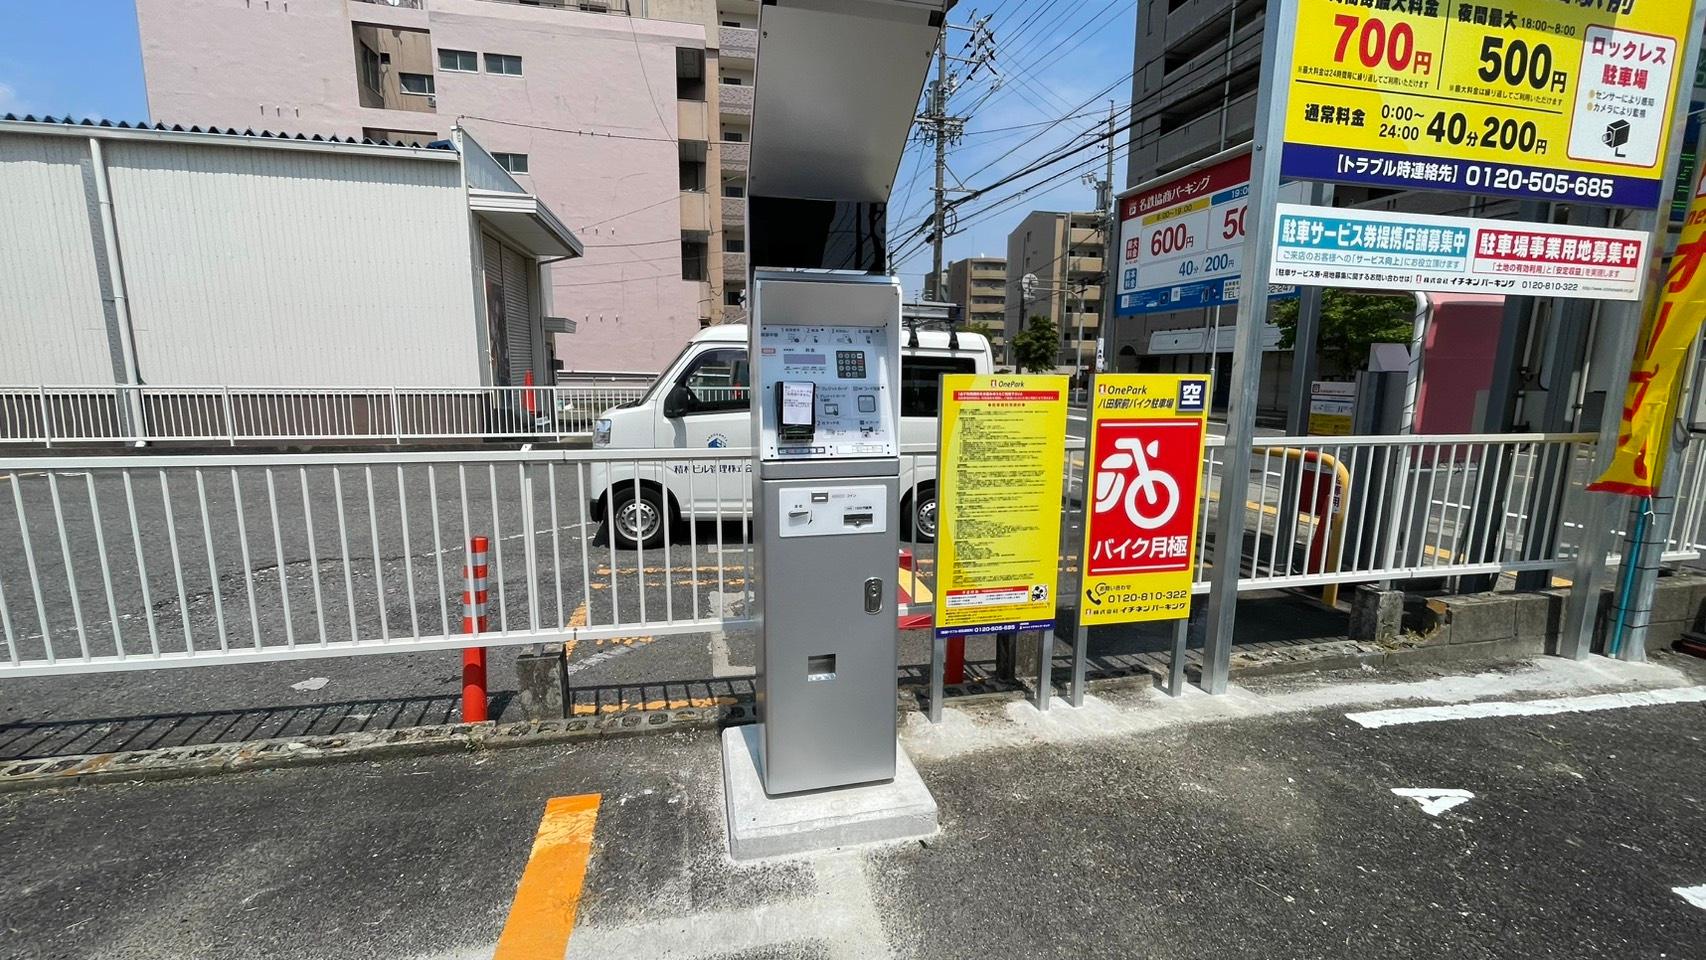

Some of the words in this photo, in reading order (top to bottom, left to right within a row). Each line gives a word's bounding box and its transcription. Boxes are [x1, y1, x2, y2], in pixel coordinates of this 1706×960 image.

[1458, 3, 1518, 30] 夜間最大
[1333, 14, 1432, 75] 700円
[1591, 36, 1667, 65] ロックレス
[1477, 35, 1567, 93] 500円
[1601, 64, 1649, 90] 駐車場
[1305, 103, 1366, 127] 通常料金
[1379, 123, 1419, 141] 24:00
[1465, 165, 1614, 199] 0120-505-685
[1151, 223, 1194, 257] 600円
[1281, 218, 1467, 254] 駐車サービス券提携店舗募集中
[1480, 232, 1638, 265] 駐車場事業用地募集中
[1521, 280, 1579, 291] 0120-810-322
[998, 380, 1025, 388] OnePark
[1107, 384, 1147, 396] OnePark
[1182, 383, 1202, 406] 空
[1097, 397, 1175, 409] 八田駅前バイク駐車場
[1092, 535, 1188, 561] バイク月極
[1107, 589, 1187, 604] 0120-810-322
[1120, 603, 1187, 614] イチネンパーキング
